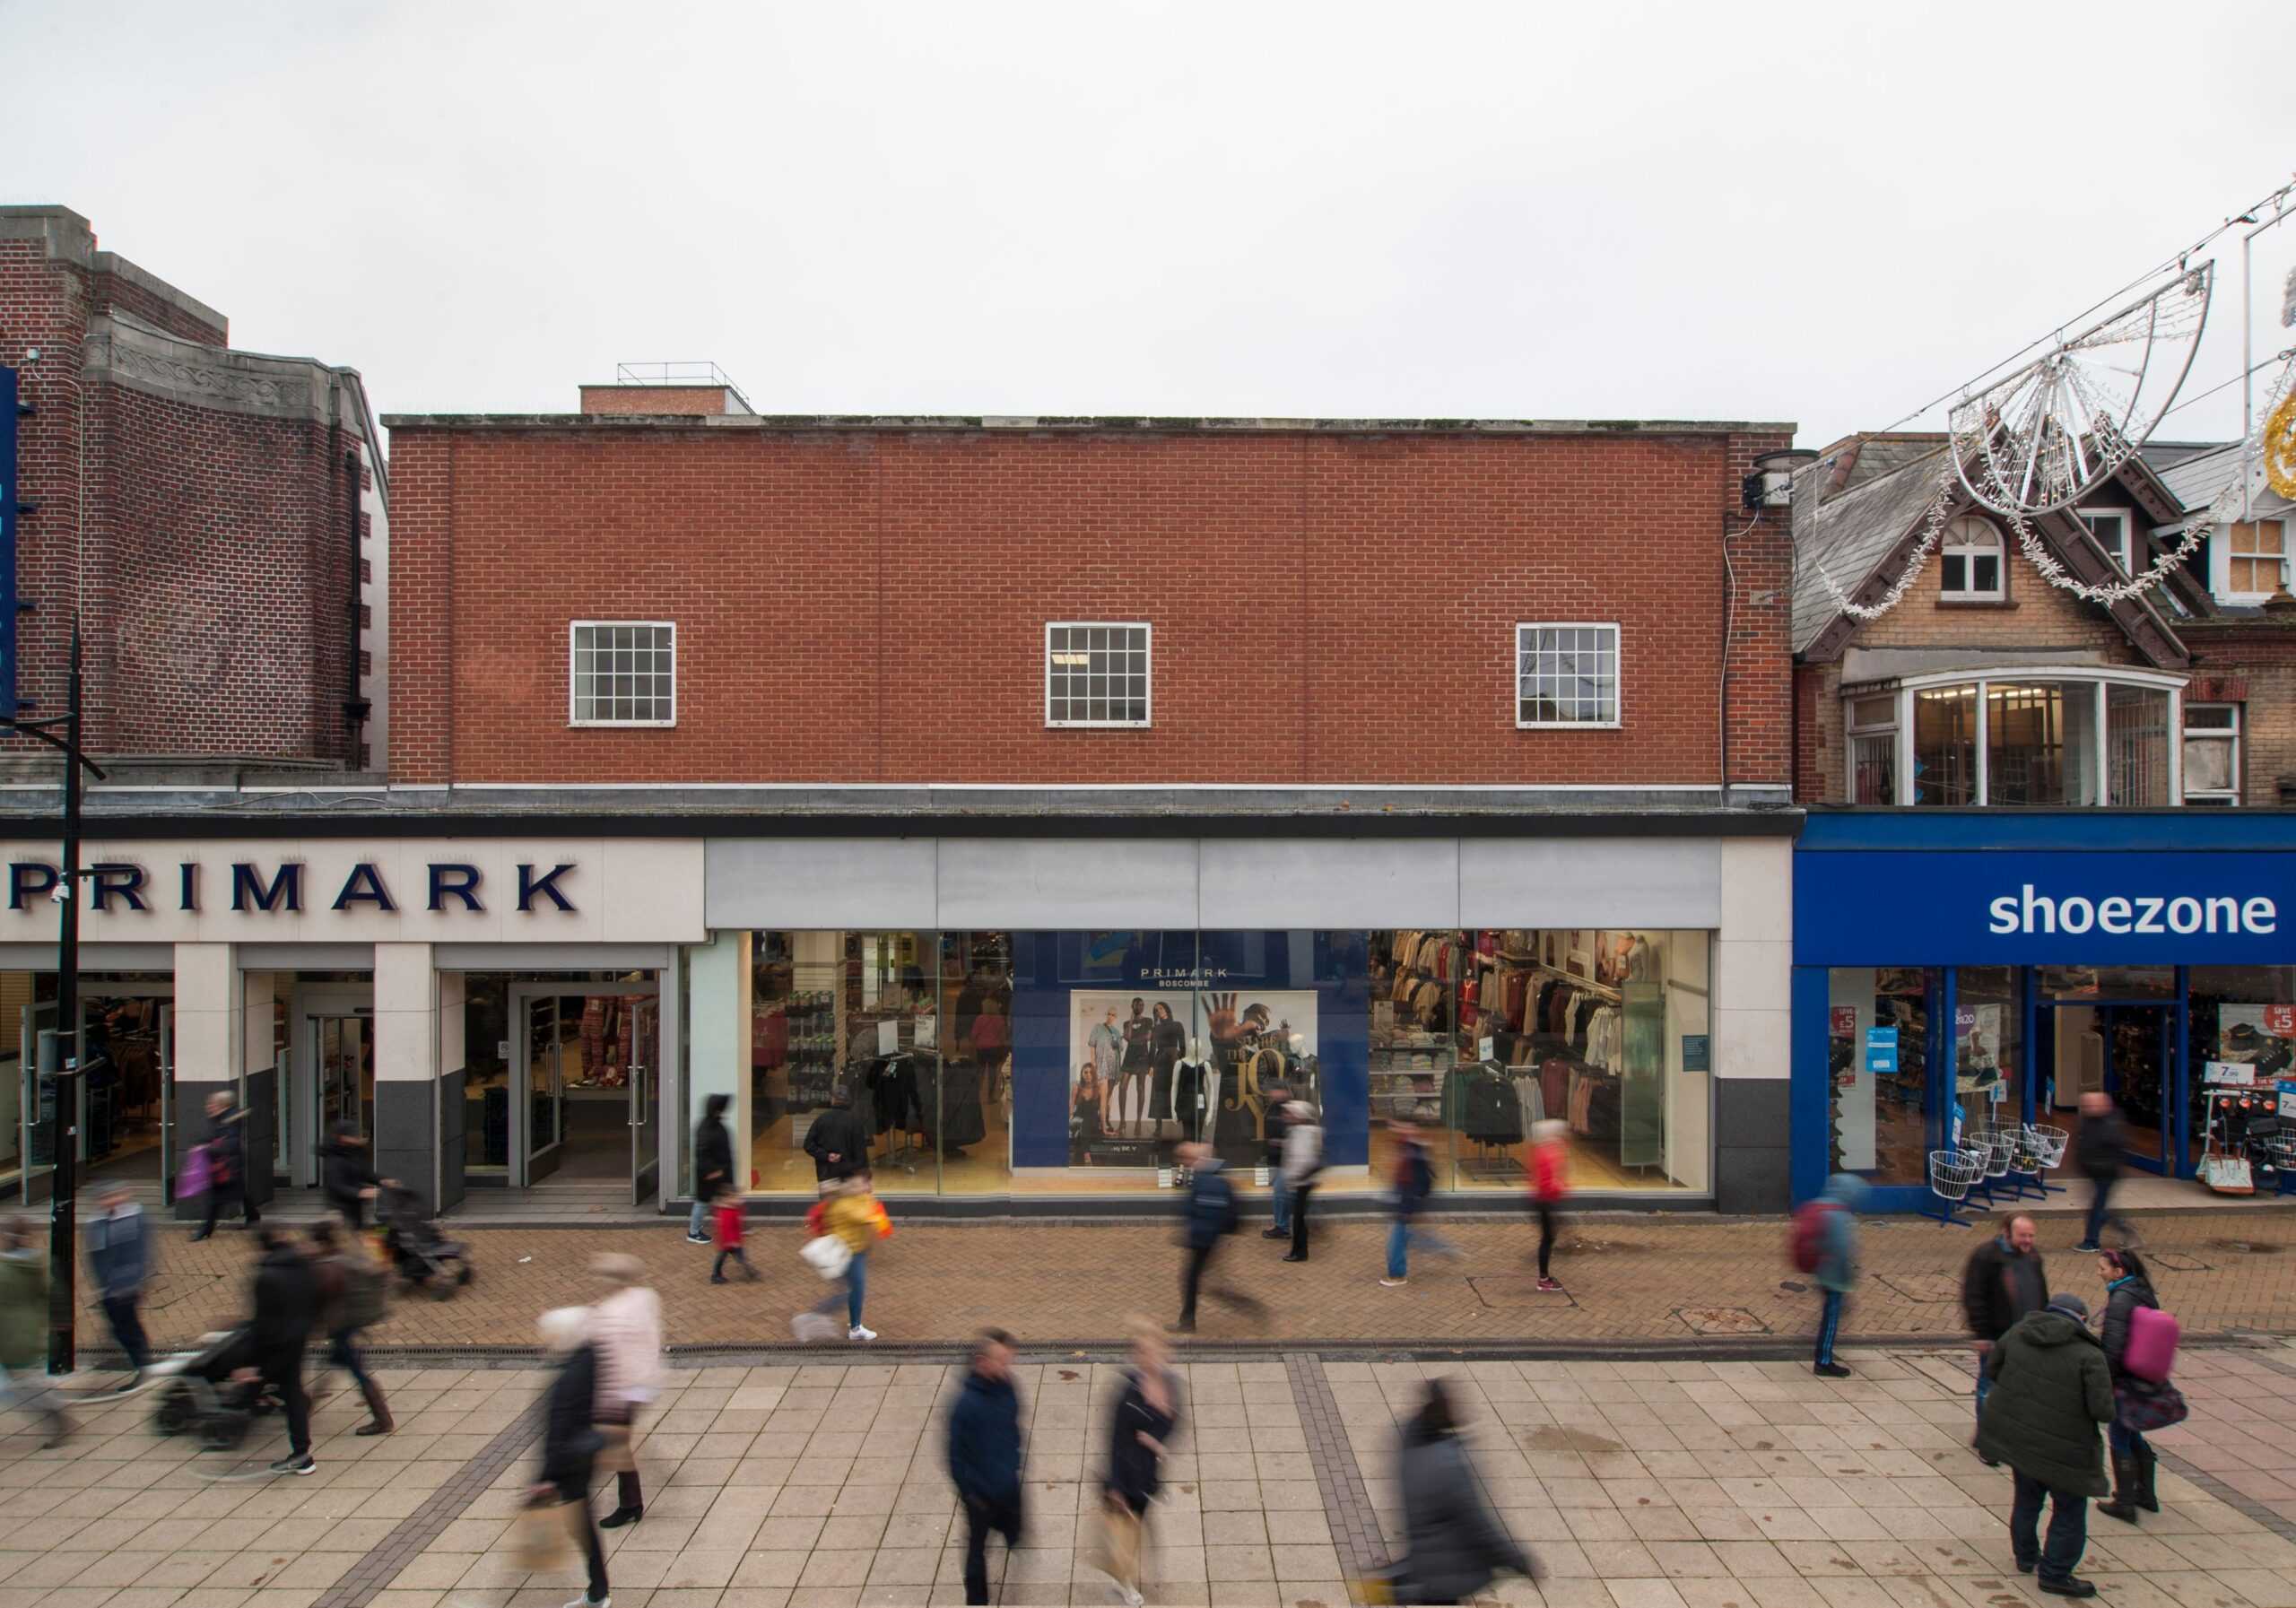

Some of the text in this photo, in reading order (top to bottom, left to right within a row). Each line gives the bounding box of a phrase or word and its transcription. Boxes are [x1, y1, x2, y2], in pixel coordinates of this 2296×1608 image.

[8, 862, 578, 911] PRIMARK
[1989, 884, 2276, 934] shoezone
[1141, 969, 1227, 978] PRIMARK
[1839, 1015, 1854, 1029] £5
[2274, 1015, 2292, 1029] £5
